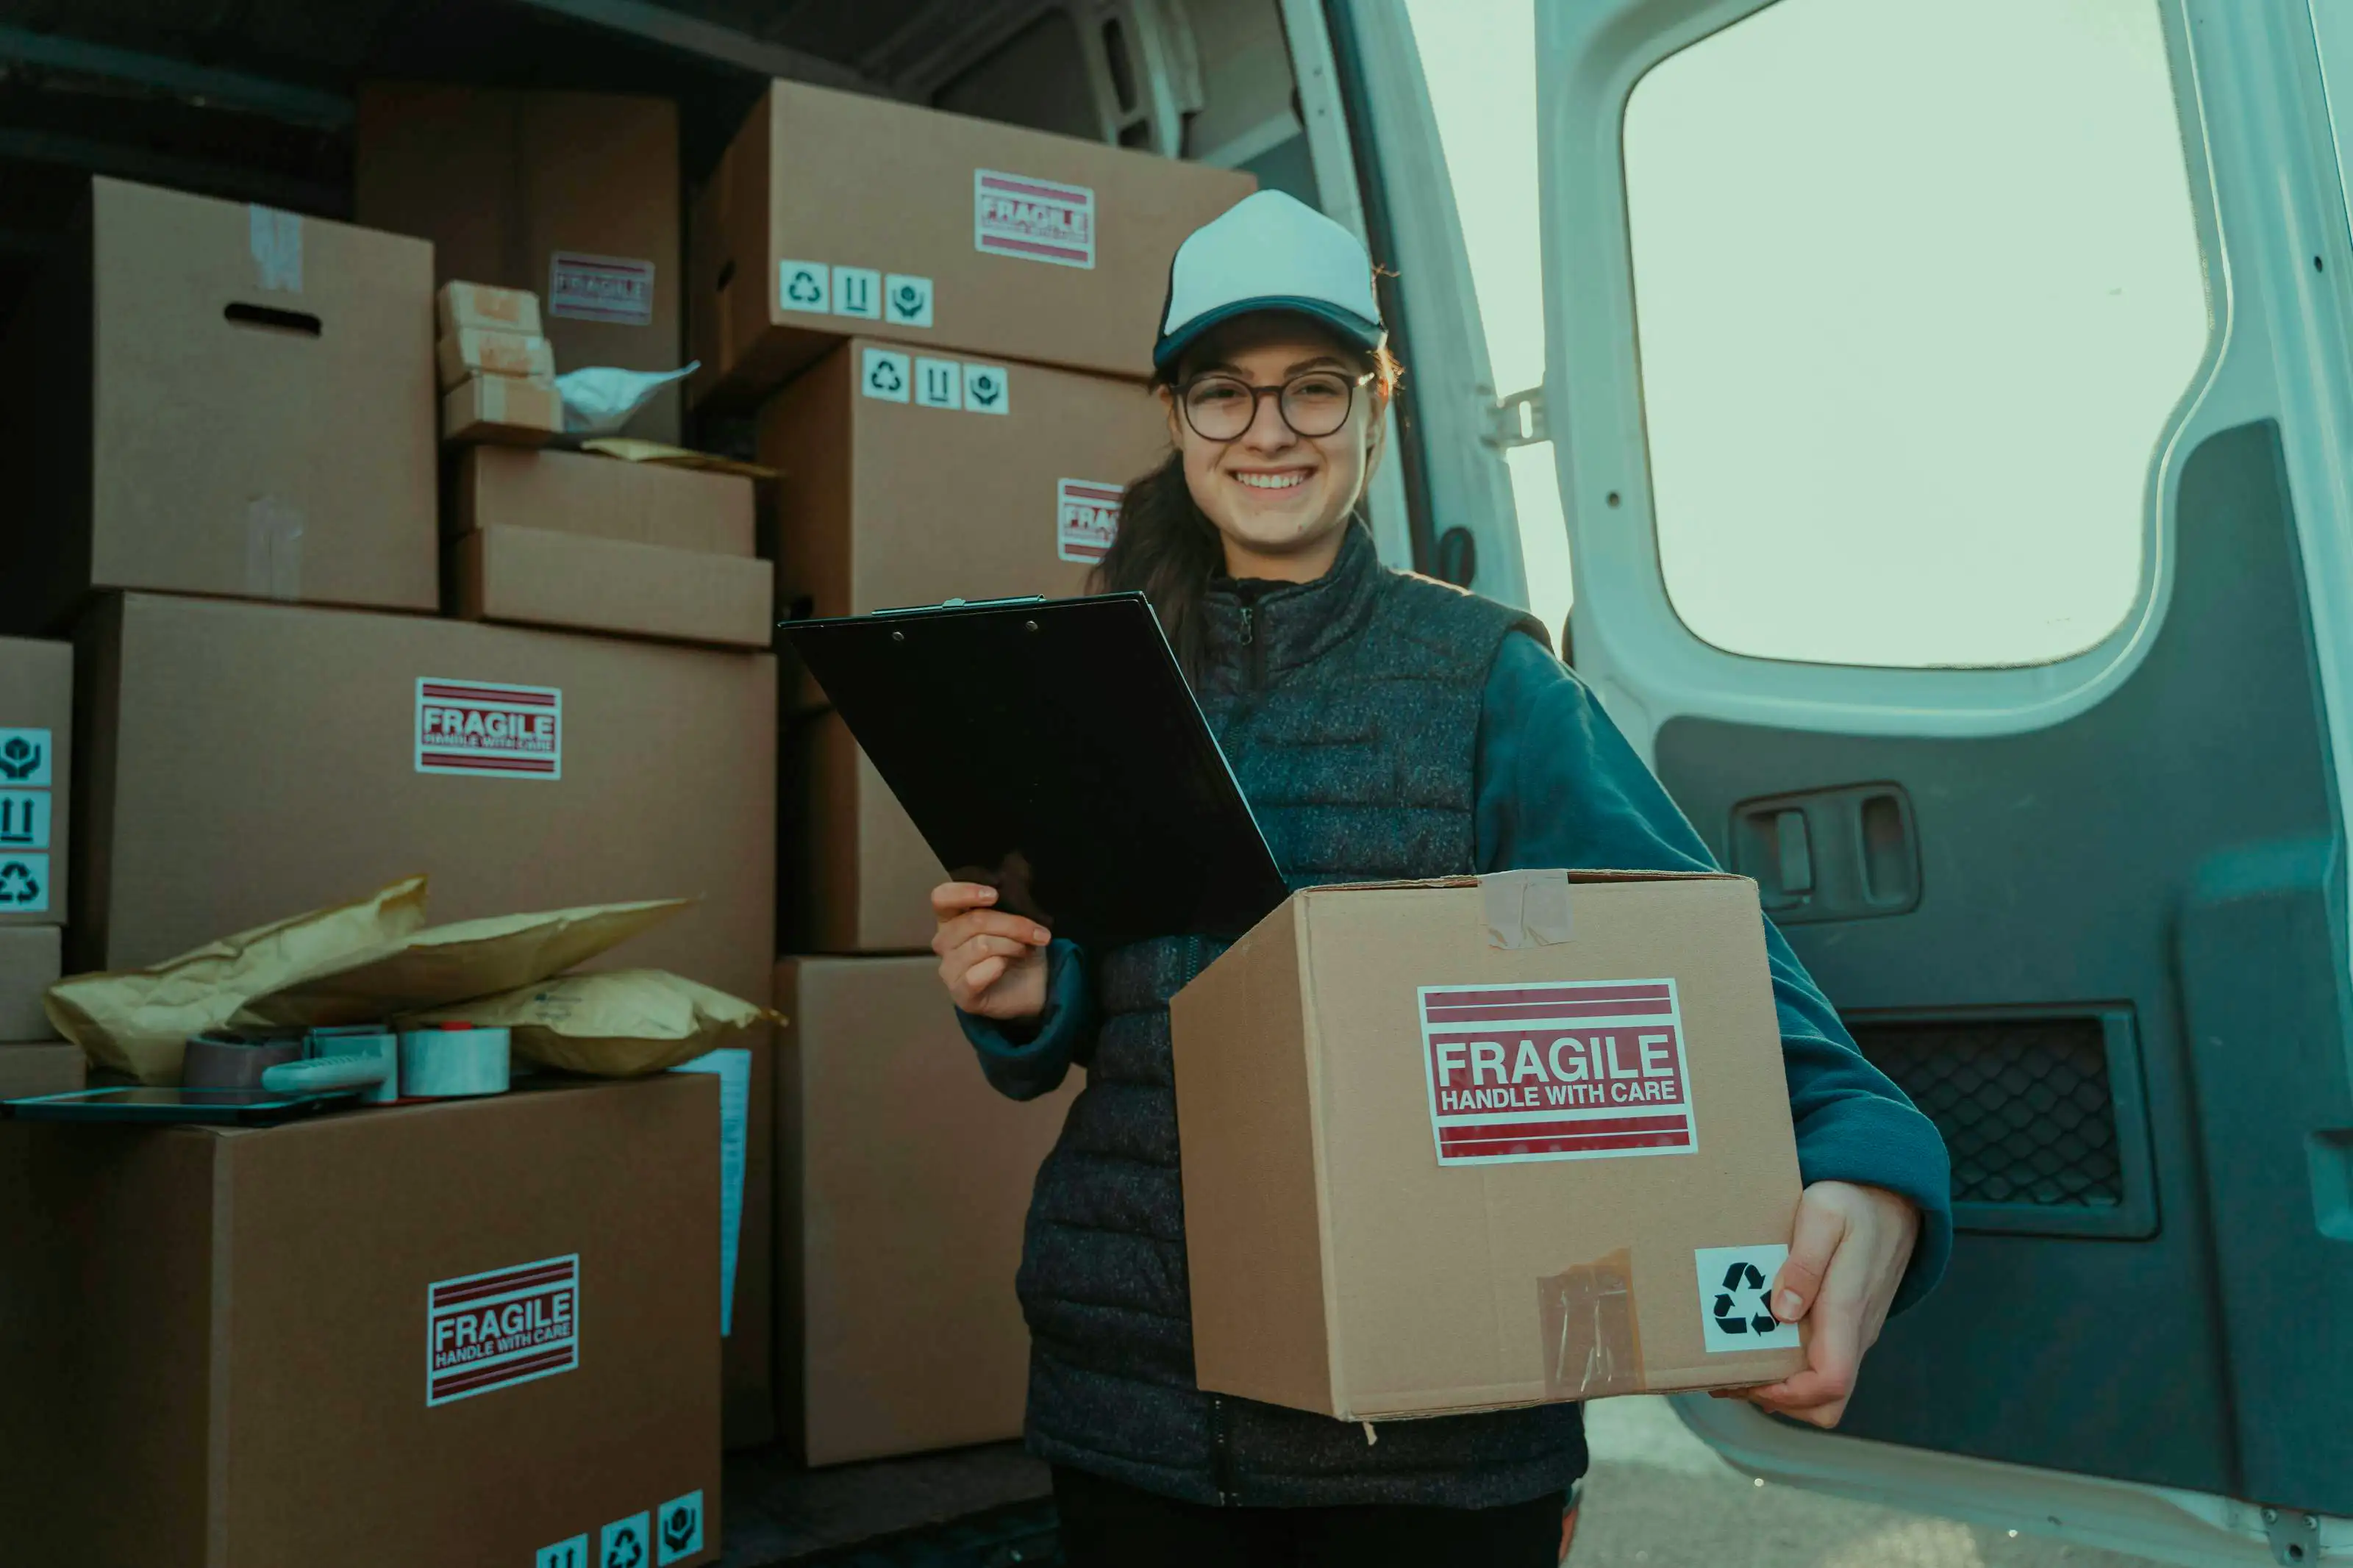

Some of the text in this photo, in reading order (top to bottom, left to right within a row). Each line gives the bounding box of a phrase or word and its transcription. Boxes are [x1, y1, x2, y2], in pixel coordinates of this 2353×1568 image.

[424, 707, 553, 740] FRAGILE
[1436, 1034, 1674, 1087] FRAGILE
[1441, 1080, 1677, 1111] HANDLE WITH CARE
[435, 1292, 571, 1351] FRAGILE
[436, 1322, 571, 1367] HANDLE WITH CARE
